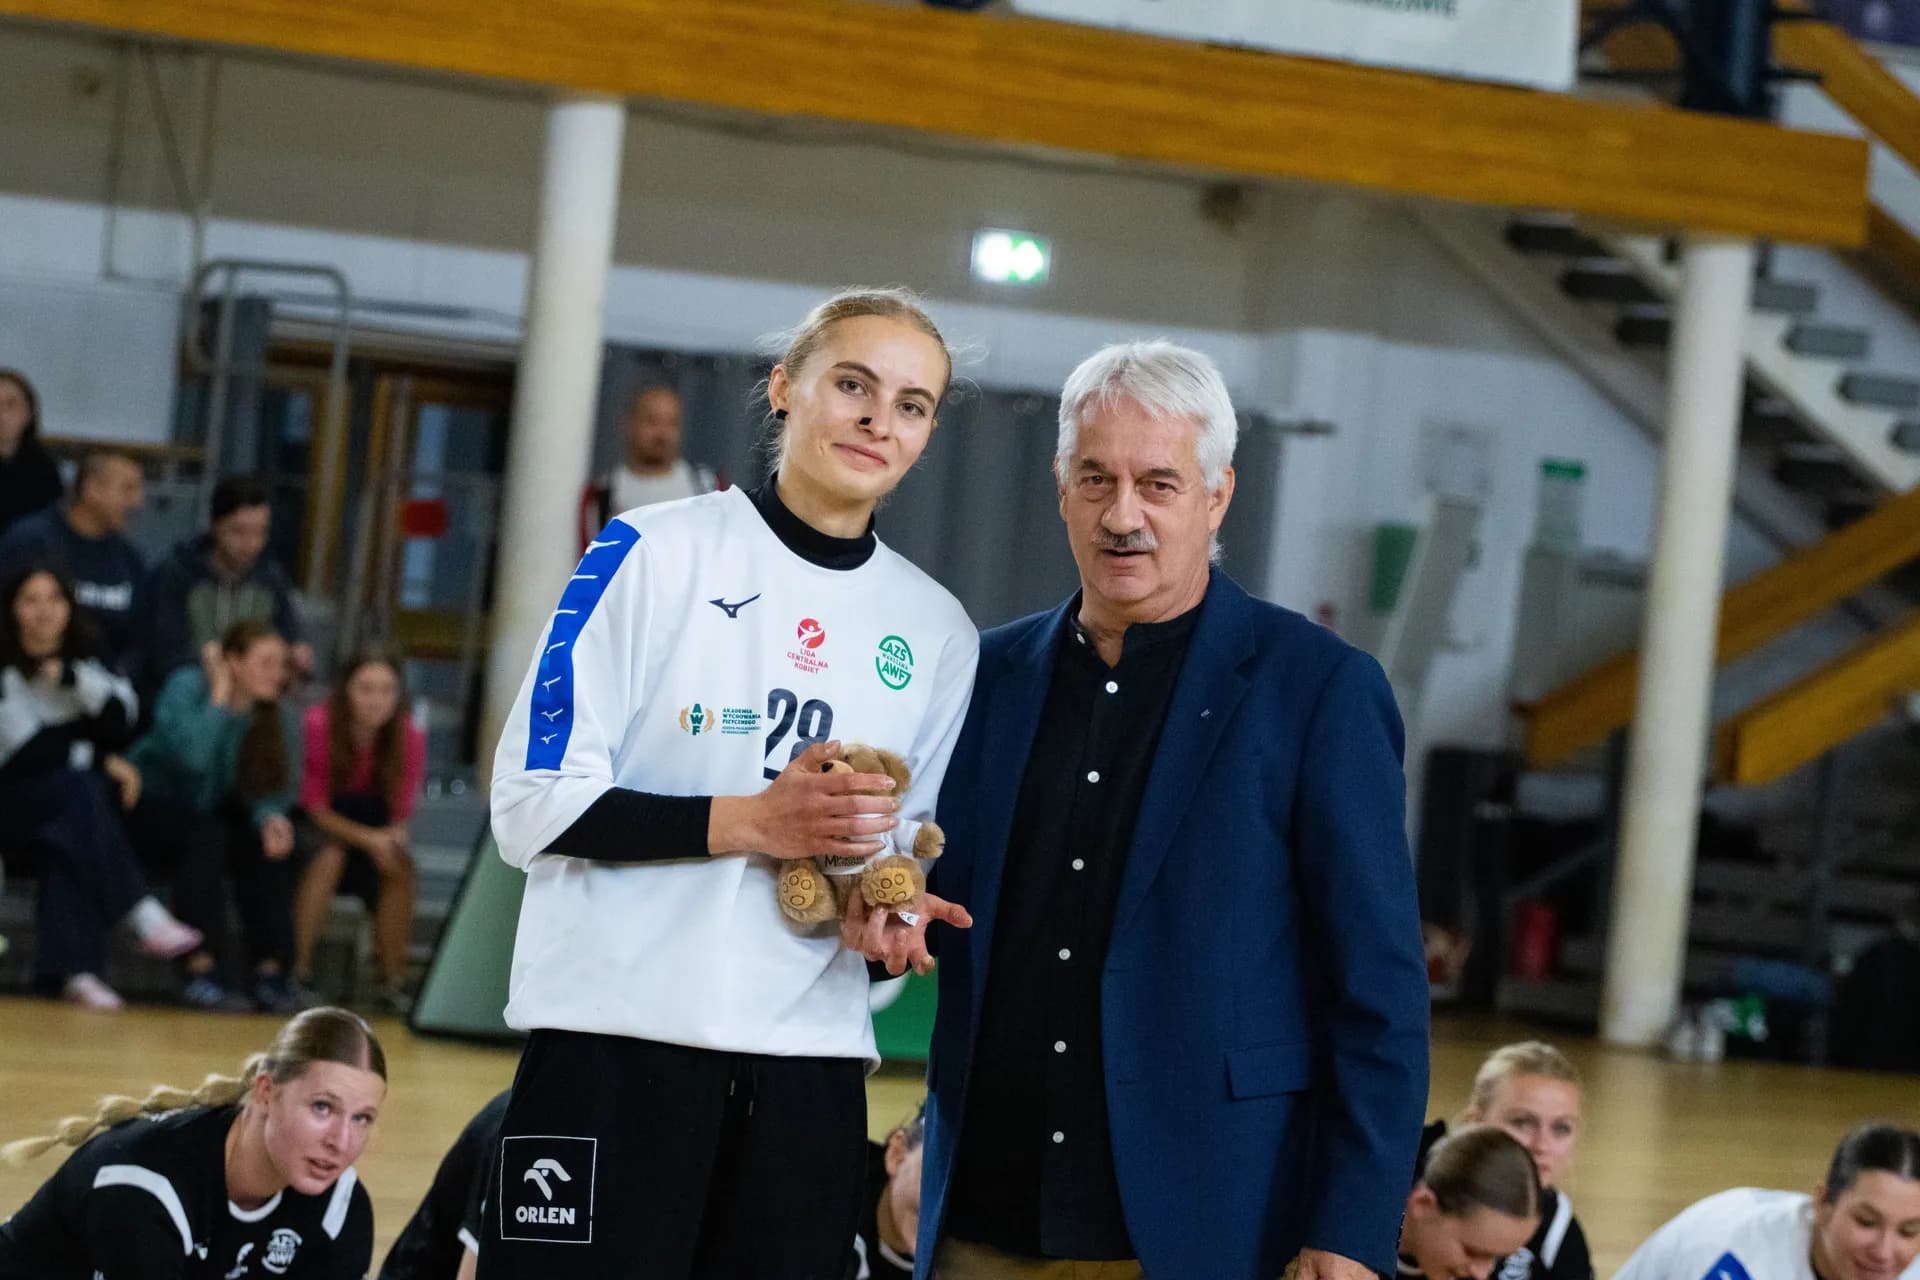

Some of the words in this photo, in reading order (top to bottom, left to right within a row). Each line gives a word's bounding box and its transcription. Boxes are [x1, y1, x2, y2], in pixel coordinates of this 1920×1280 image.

[787, 651, 829, 668] CENTRALNA
[886, 642, 907, 661] AZS
[794, 662, 820, 674] KOBIET
[882, 661, 906, 681] AWF
[763, 688, 834, 782] 28
[515, 1205, 576, 1225] ORLEN
